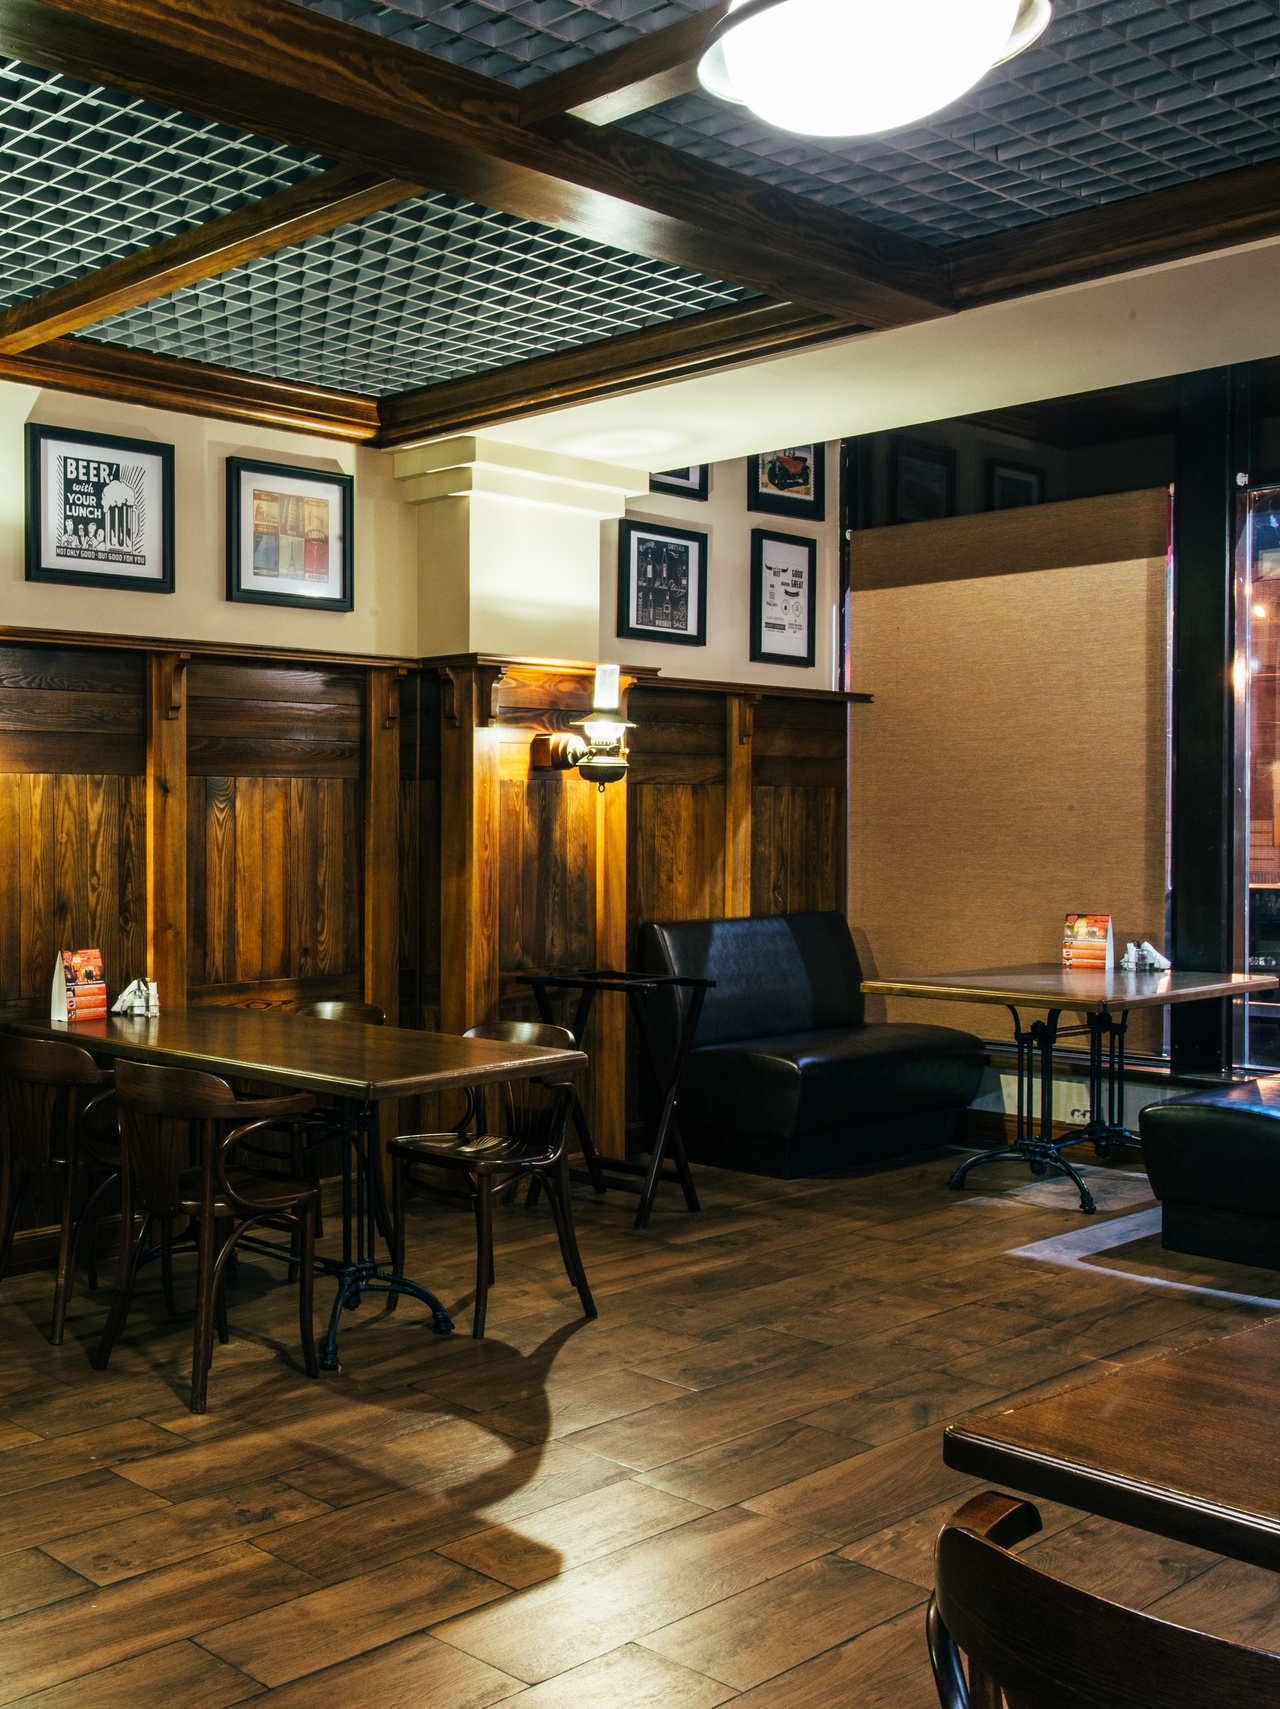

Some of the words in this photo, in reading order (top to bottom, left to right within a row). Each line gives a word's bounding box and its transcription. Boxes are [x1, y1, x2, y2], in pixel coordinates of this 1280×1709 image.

[66, 458, 117, 484] BEER!
[72, 482, 94, 494] with
[67, 493, 97, 507] YOUR
[66, 504, 102, 519] LUNCH
[80, 550, 95, 558] GOOD
[108, 553, 122, 561] GOOD
[134, 556, 145, 564] YOU
